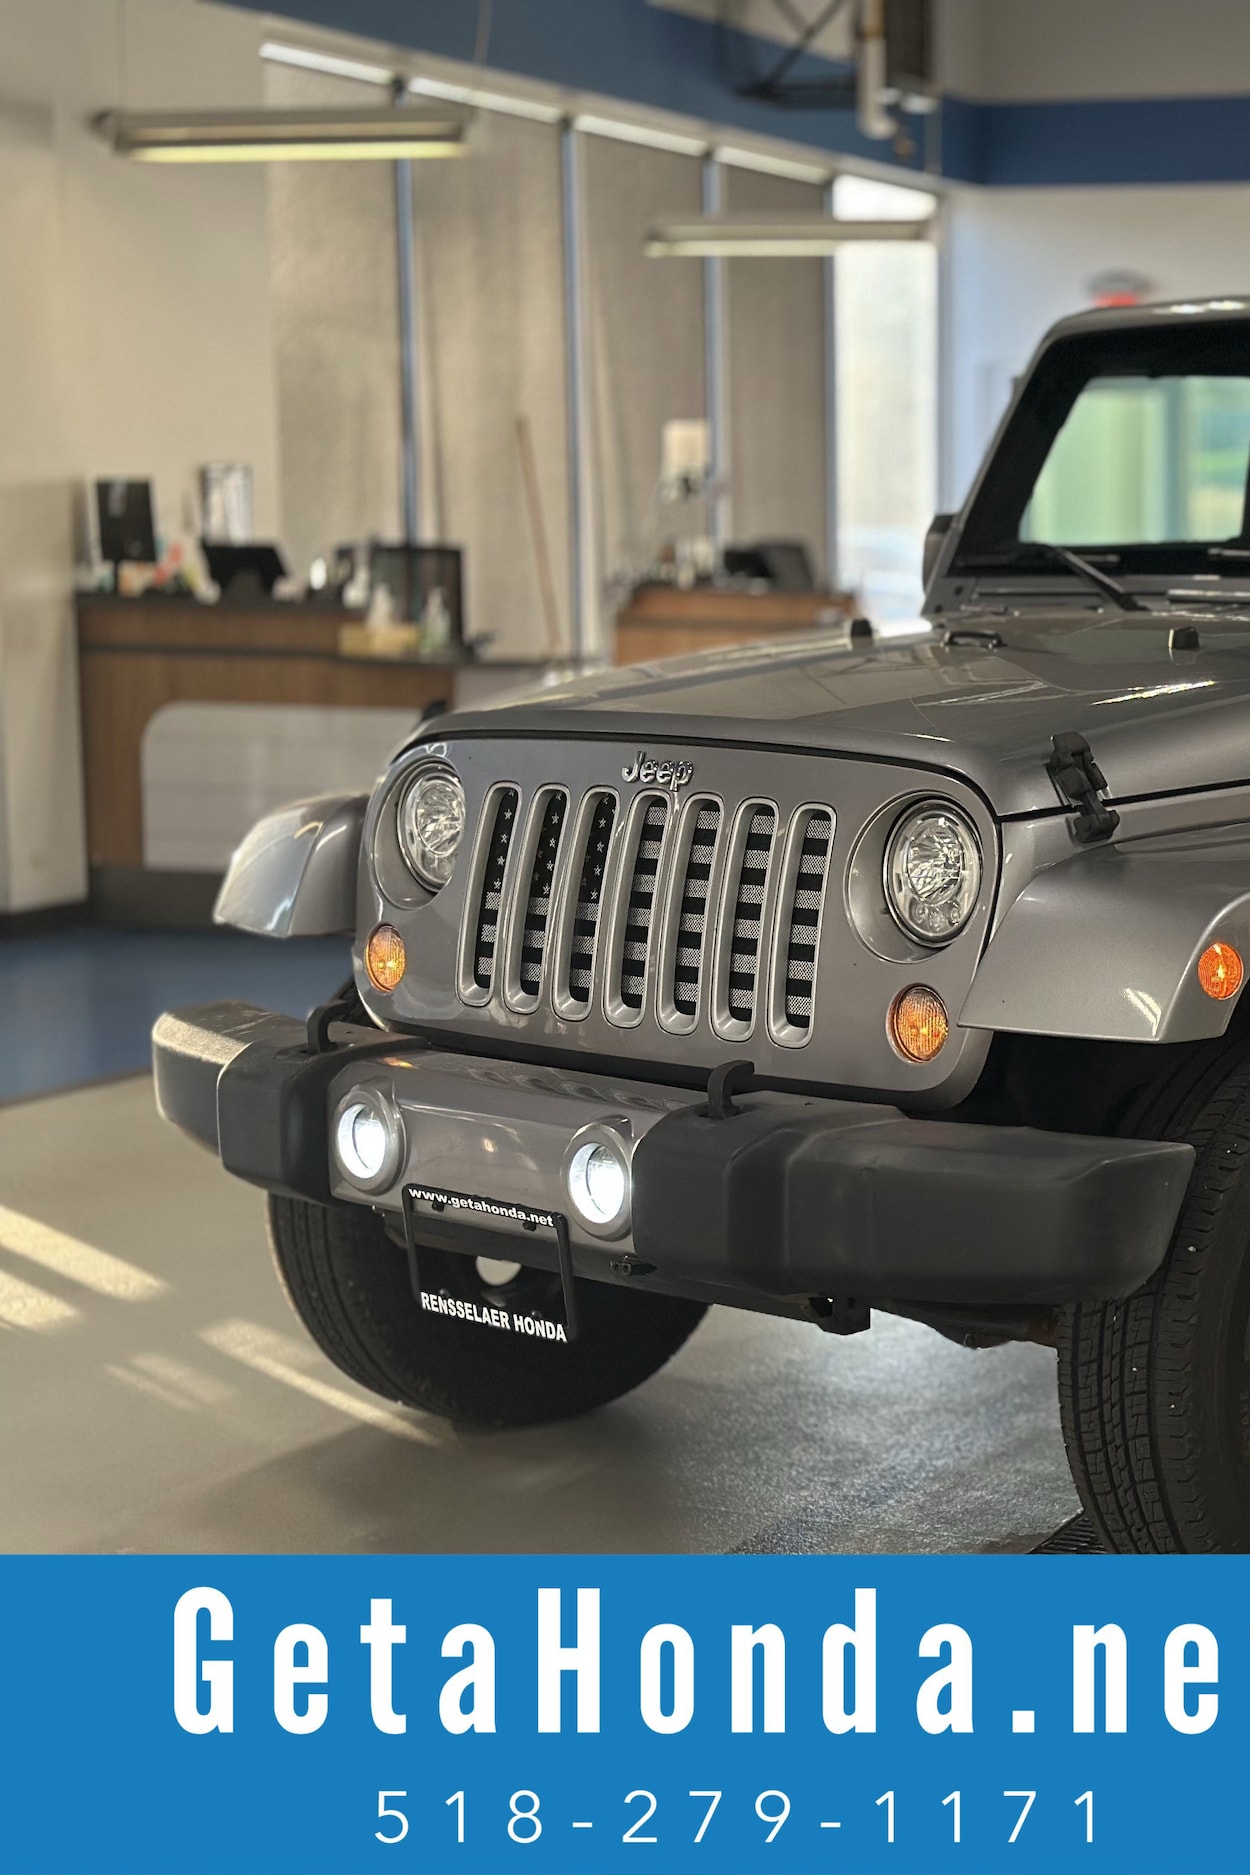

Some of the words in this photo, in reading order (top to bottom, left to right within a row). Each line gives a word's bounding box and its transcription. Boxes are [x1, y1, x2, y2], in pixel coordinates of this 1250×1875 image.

[621, 750, 694, 792] Jeep
[408, 1187, 554, 1228] www.getahonda.net
[420, 1291, 511, 1330] RENSSELAER
[513, 1312, 568, 1343] HONDA
